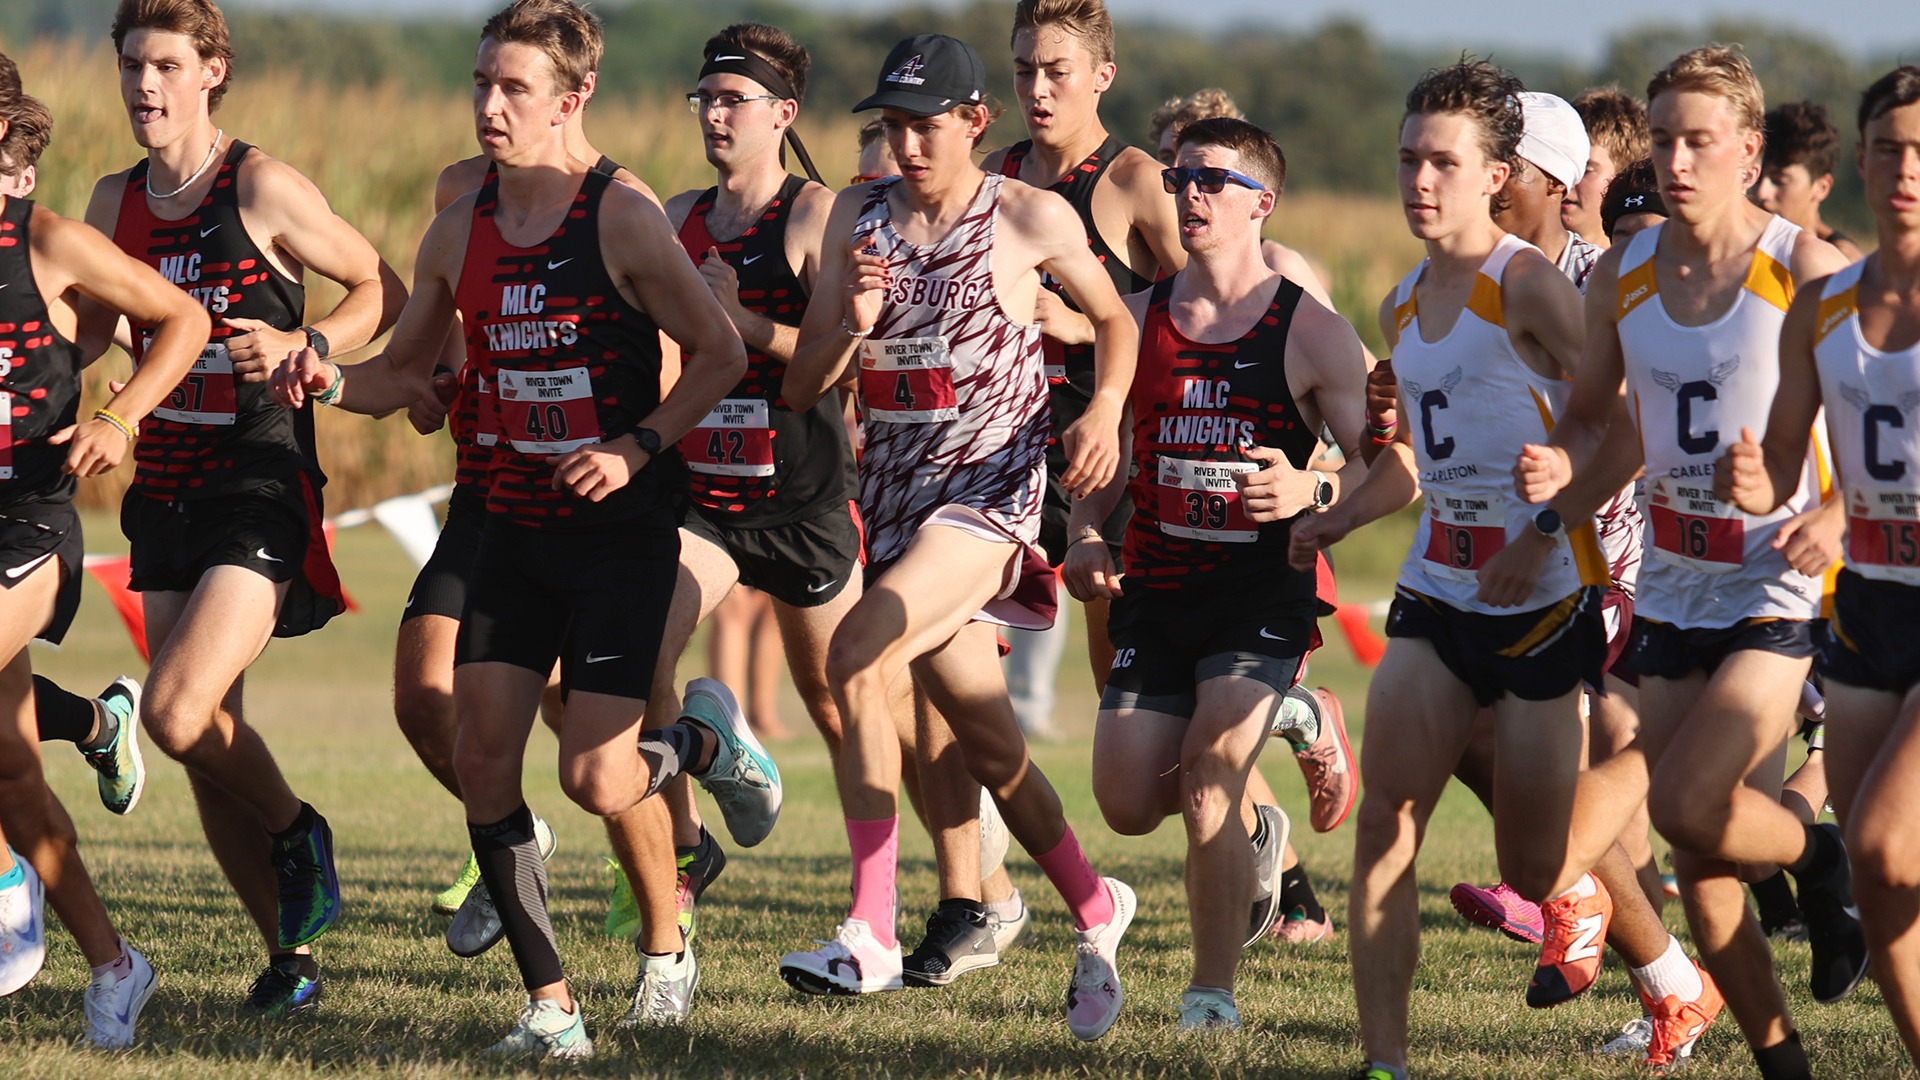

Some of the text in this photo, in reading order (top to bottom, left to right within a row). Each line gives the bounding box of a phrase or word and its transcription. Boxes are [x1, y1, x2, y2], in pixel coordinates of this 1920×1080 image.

[892, 54, 924, 76] A
[159, 253, 201, 284] MLC
[501, 284, 546, 316] MLC
[882, 277, 979, 310] GSBURG
[483, 321, 578, 351] KNIGHTS
[885, 343, 932, 354] RIVER TOWN
[192, 360, 207, 369] ITE
[897, 355, 922, 366] INVITE
[525, 375, 573, 387] RIVER TOWN
[538, 387, 563, 398] INVITE
[894, 372, 915, 410] 4
[1182, 379, 1231, 409] MLC
[526, 404, 568, 441] 40
[723, 415, 744, 424] INVITE
[734, 404, 754, 414] TOWN
[1677, 380, 1719, 455] C
[1158, 415, 1255, 448] KNIGHTS
[1420, 389, 1455, 461] C
[706, 430, 746, 464] 42
[1864, 404, 1906, 482] C
[1194, 467, 1216, 476] RIVER
[1205, 478, 1231, 488] INVITE
[1425, 464, 1478, 483] CARLETON
[1464, 500, 1488, 510] TOWN
[1677, 487, 1700, 498] RIVER
[1689, 500, 1715, 512] INVITE
[1185, 492, 1228, 529] 39
[1445, 527, 1473, 569] 19
[1676, 515, 1709, 559] 16
[1882, 523, 1919, 565] 15
[1563, 557, 1569, 566] 2
[1564, 914, 1603, 964] N
